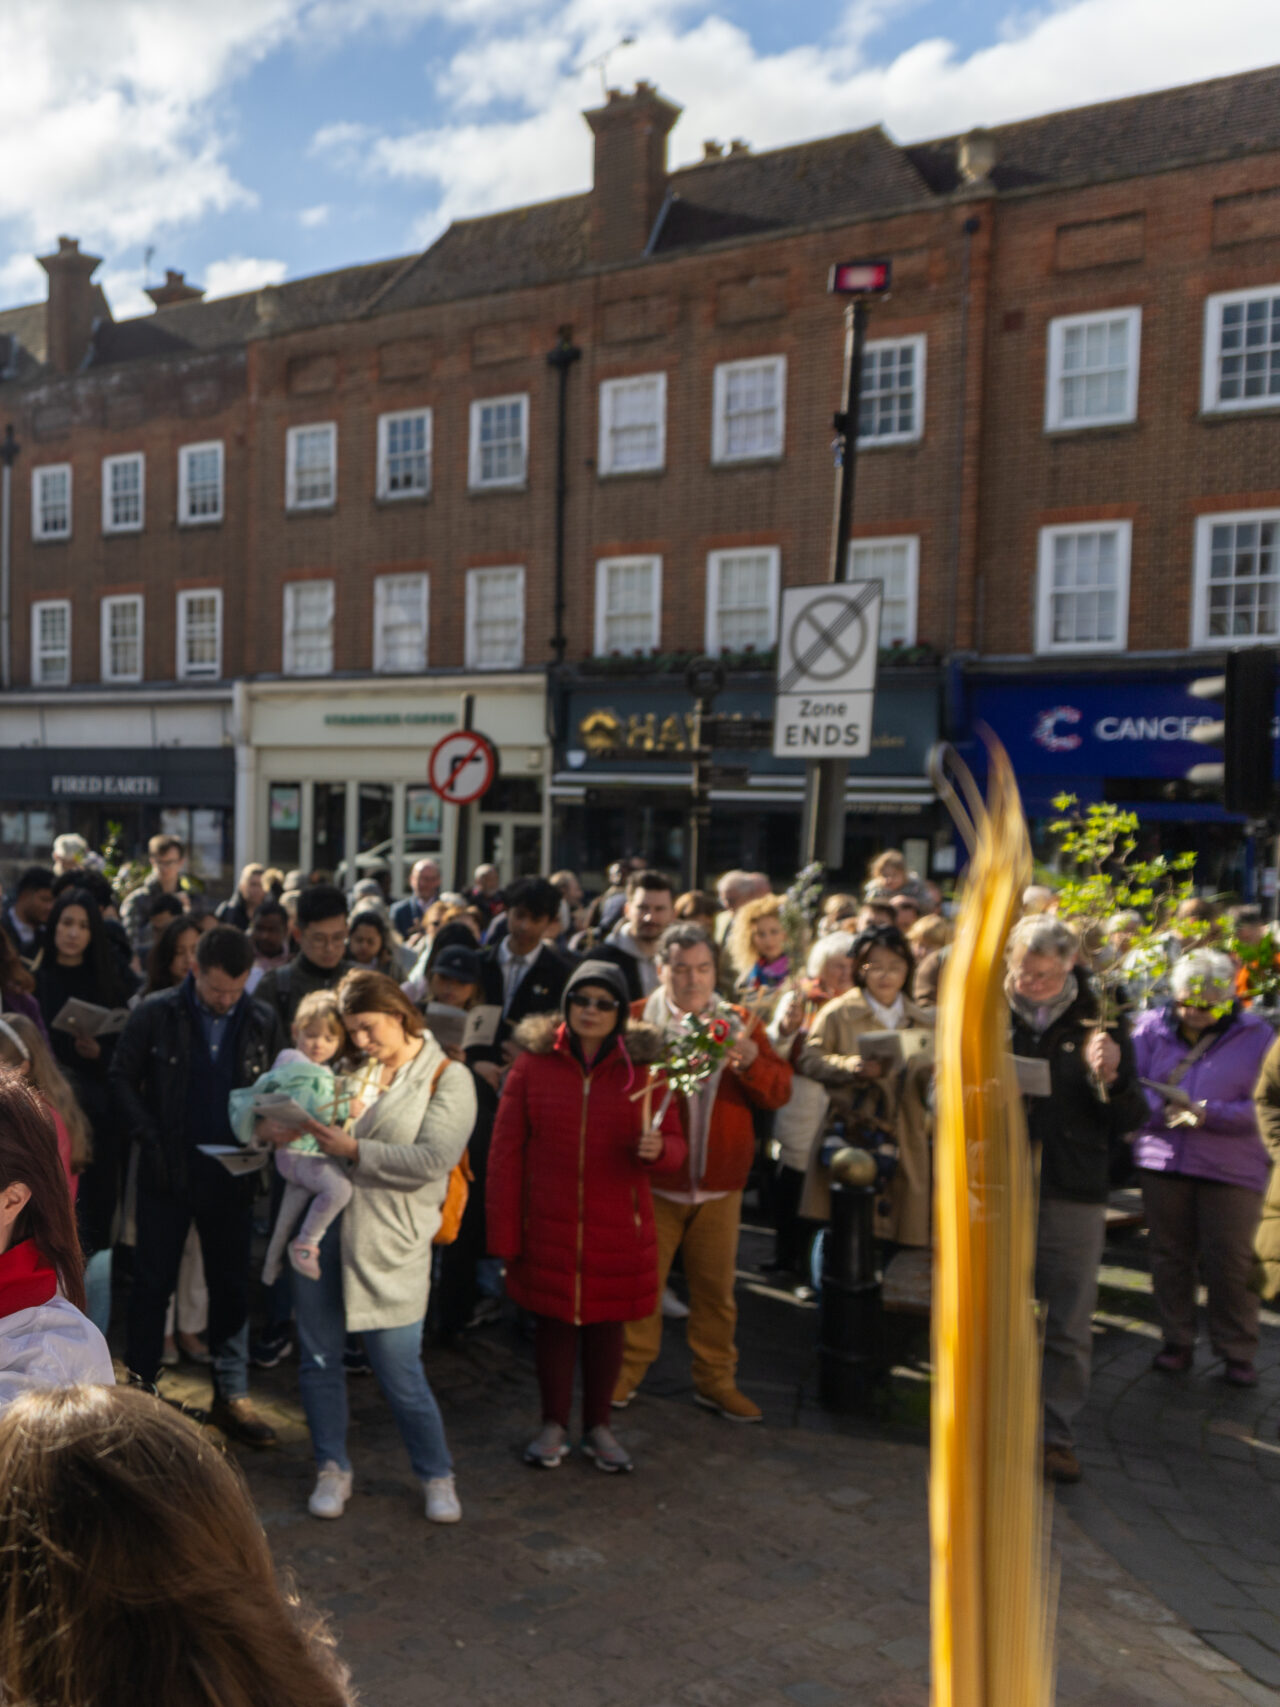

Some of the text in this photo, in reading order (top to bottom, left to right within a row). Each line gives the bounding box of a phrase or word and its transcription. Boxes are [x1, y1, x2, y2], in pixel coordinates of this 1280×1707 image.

[799, 699, 848, 718] Zone
[784, 723, 860, 747] ENDS
[51, 775, 160, 796] FIRED EARTH
